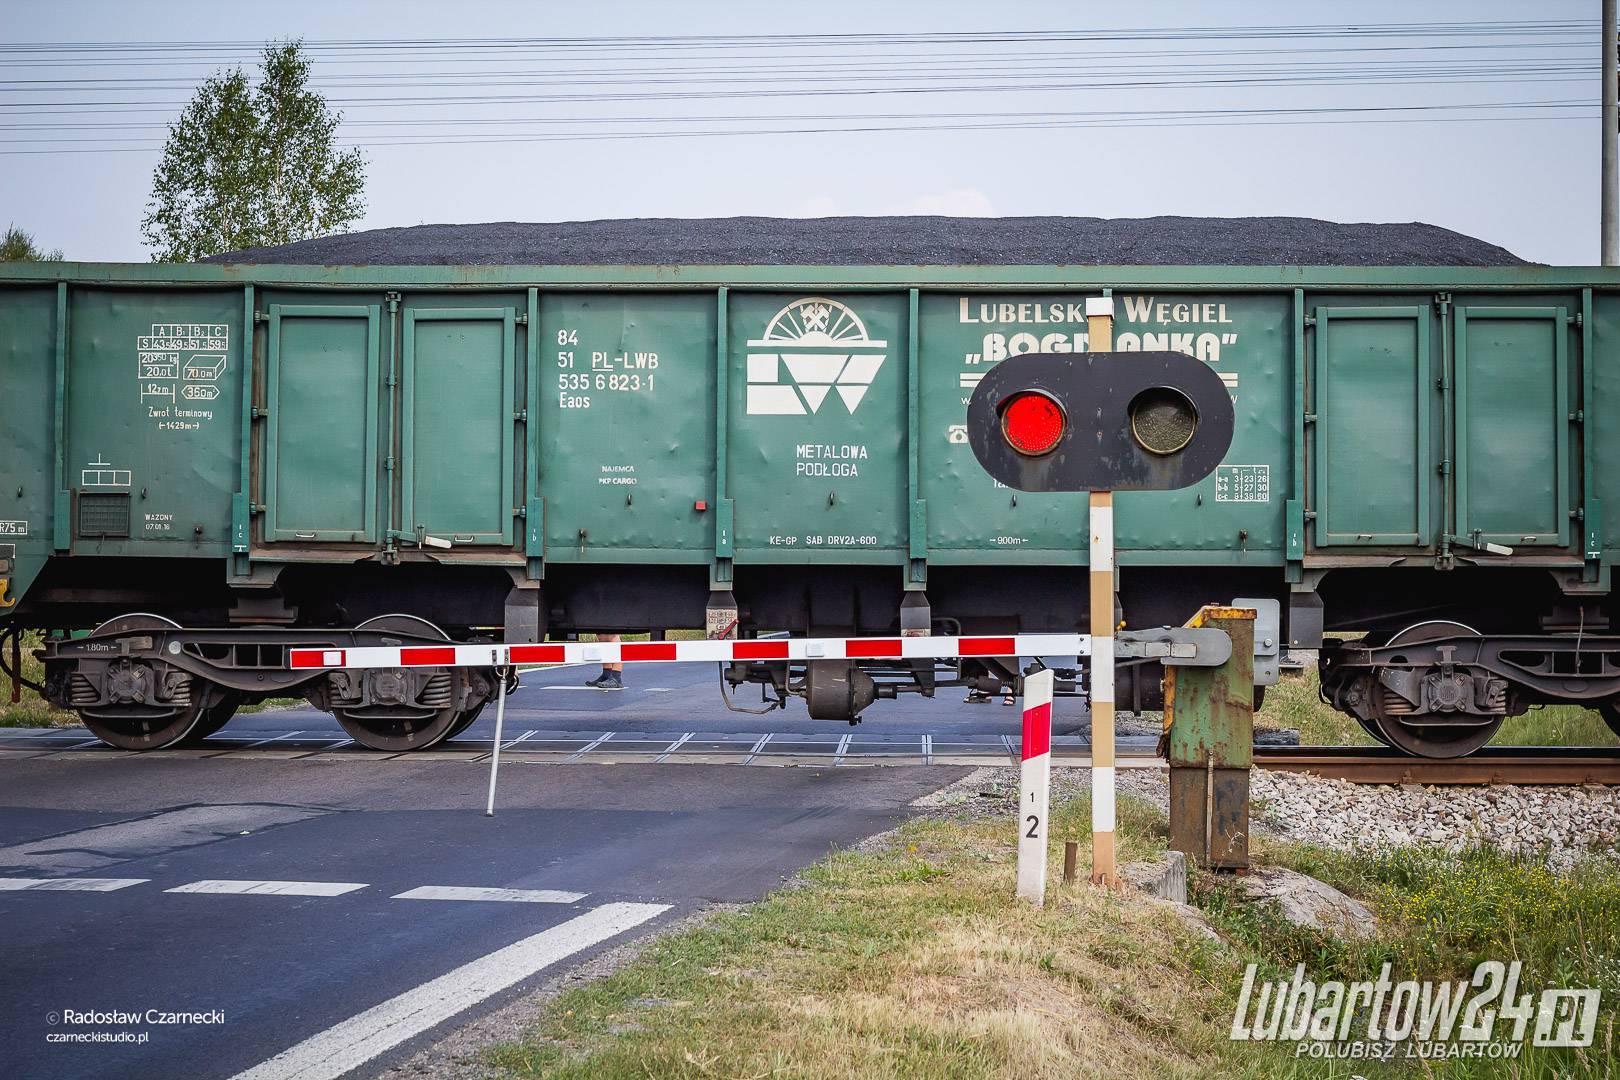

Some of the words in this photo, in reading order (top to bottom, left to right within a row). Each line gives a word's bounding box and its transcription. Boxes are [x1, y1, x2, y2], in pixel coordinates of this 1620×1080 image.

[959, 297, 1092, 323] LUBELSK
[1123, 296, 1233, 326] WĘGIEL
[159, 326, 165, 336] A
[214, 326, 221, 336] C
[142, 339, 149, 348] S
[557, 329, 578, 346] 84
[557, 351, 574, 368] 51
[592, 351, 659, 371] PL-LWB
[558, 374, 590, 390] 535
[559, 391, 590, 408] Eaos
[148, 406, 170, 417] Zwrot
[174, 406, 213, 420] terminowy
[796, 444, 868, 459] METALOWA
[601, 465, 635, 473] NAJEMCA
[796, 462, 858, 477] PODŁOGA
[612, 477, 638, 485] CARGO
[1244, 475, 1254, 483] 23
[1257, 475, 1267, 483] 26
[1244, 484, 1253, 492] 27
[1257, 484, 1267, 492] 30
[0, 522, 16, 533] R75
[769, 536, 798, 546] KE-GP
[806, 535, 823, 545] SAB
[1030, 792, 1034, 802] 1
[1026, 815, 1039, 838] 2
